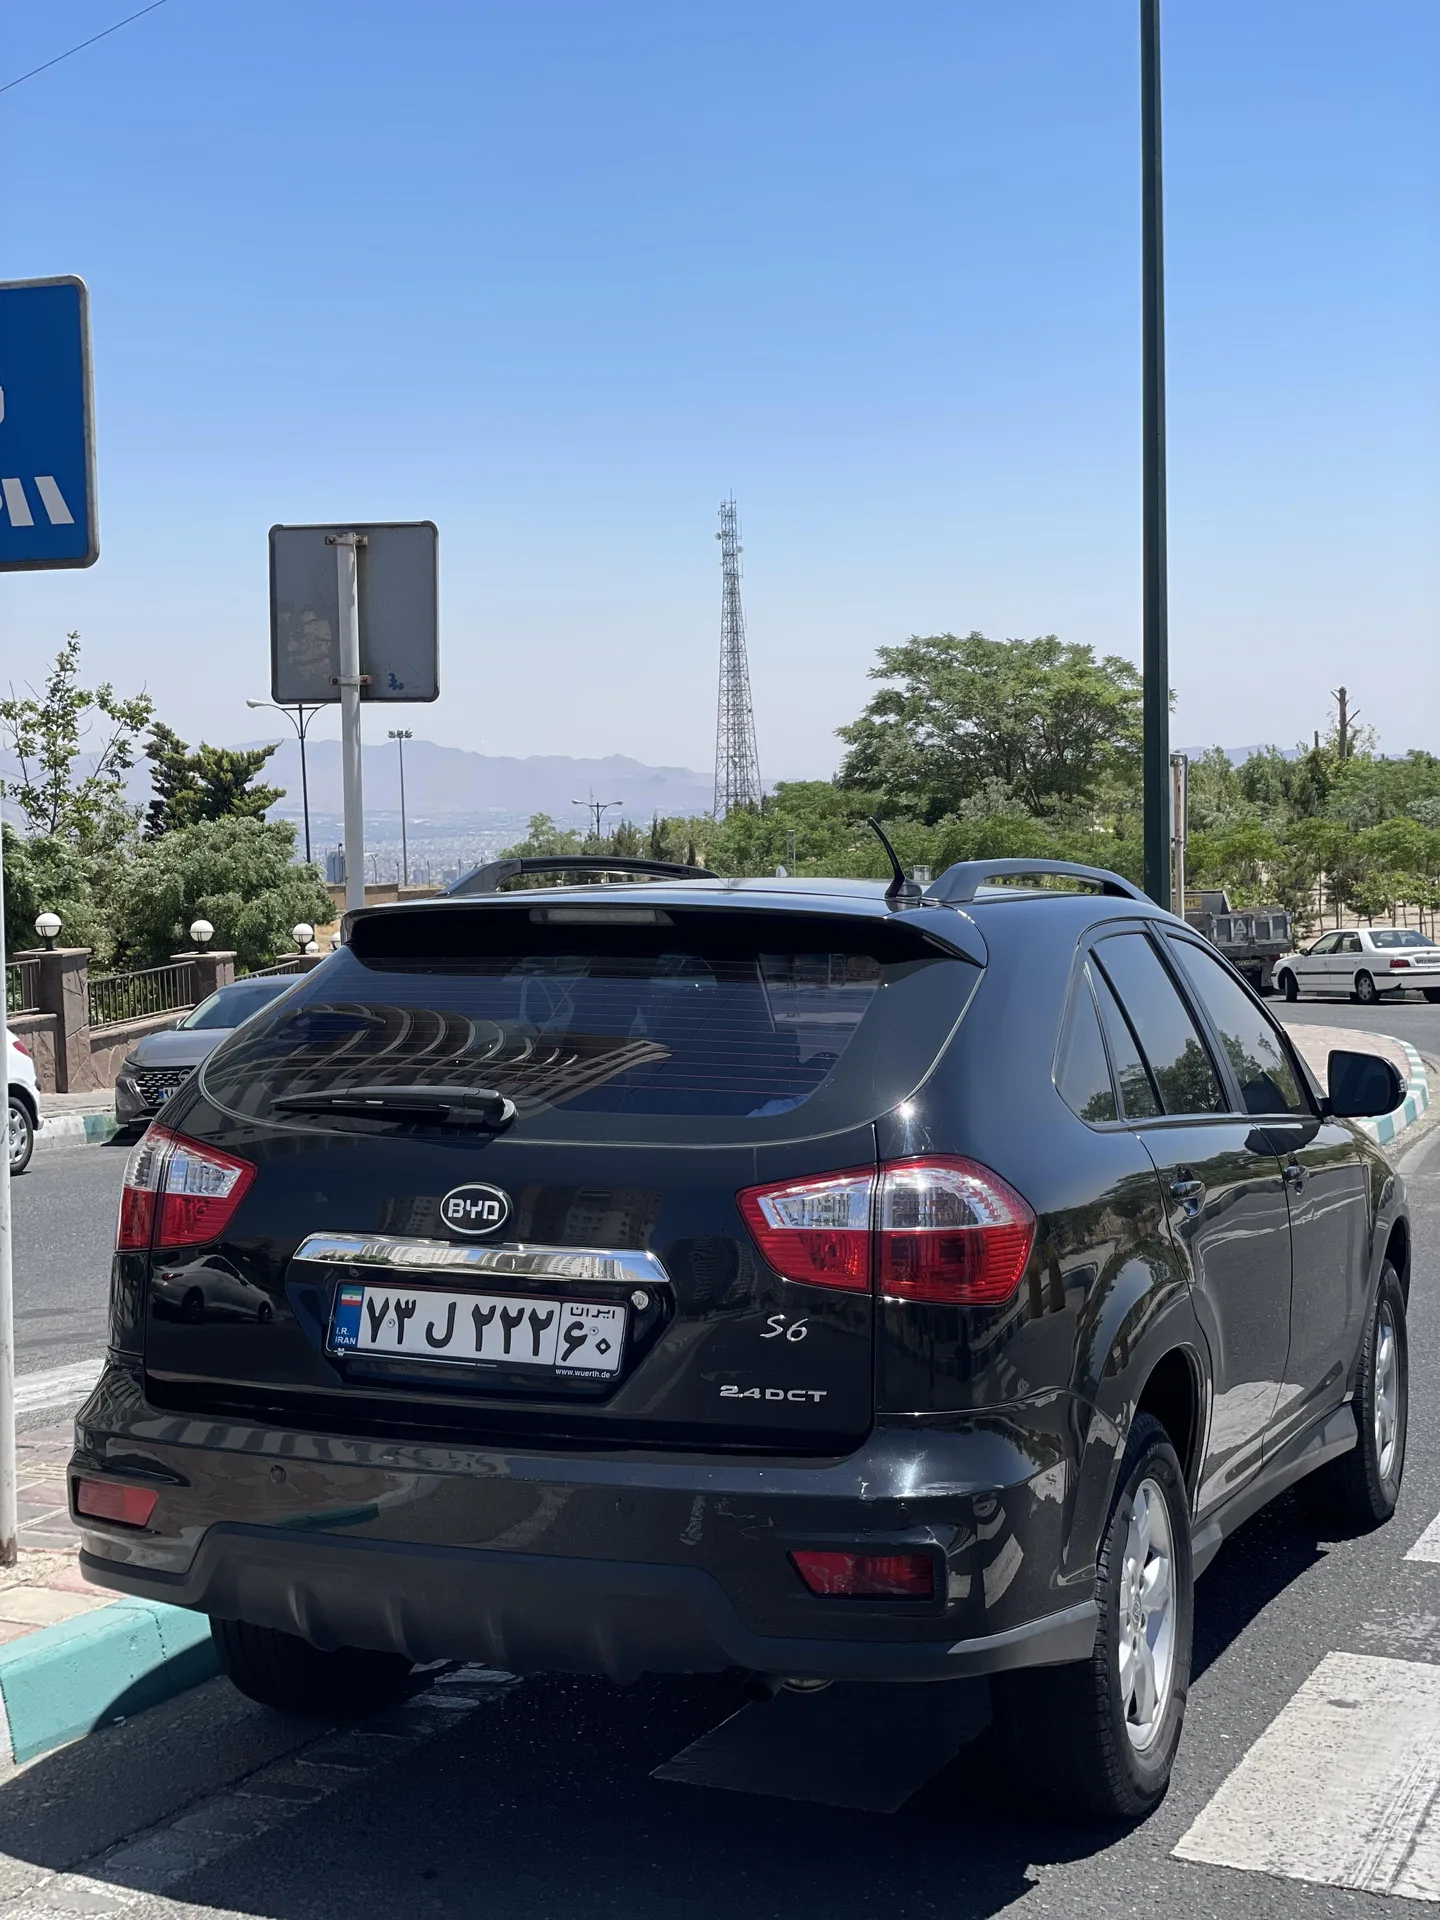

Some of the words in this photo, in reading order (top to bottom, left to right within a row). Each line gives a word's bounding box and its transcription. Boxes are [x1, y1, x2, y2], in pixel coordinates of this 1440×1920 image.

[447, 1198, 500, 1220] BYD
[570, 1306, 616, 1320] ایران
[335, 1326, 350, 1335] I.R.
[366, 1295, 417, 1345] ۷۳
[425, 1301, 457, 1349] ل
[471, 1303, 555, 1357] ۲۲۲
[760, 1314, 808, 1341] S6
[334, 1336, 356, 1345] IRAN
[560, 1320, 612, 1362] ۶۰
[555, 1368, 611, 1379] www.wuerth.de
